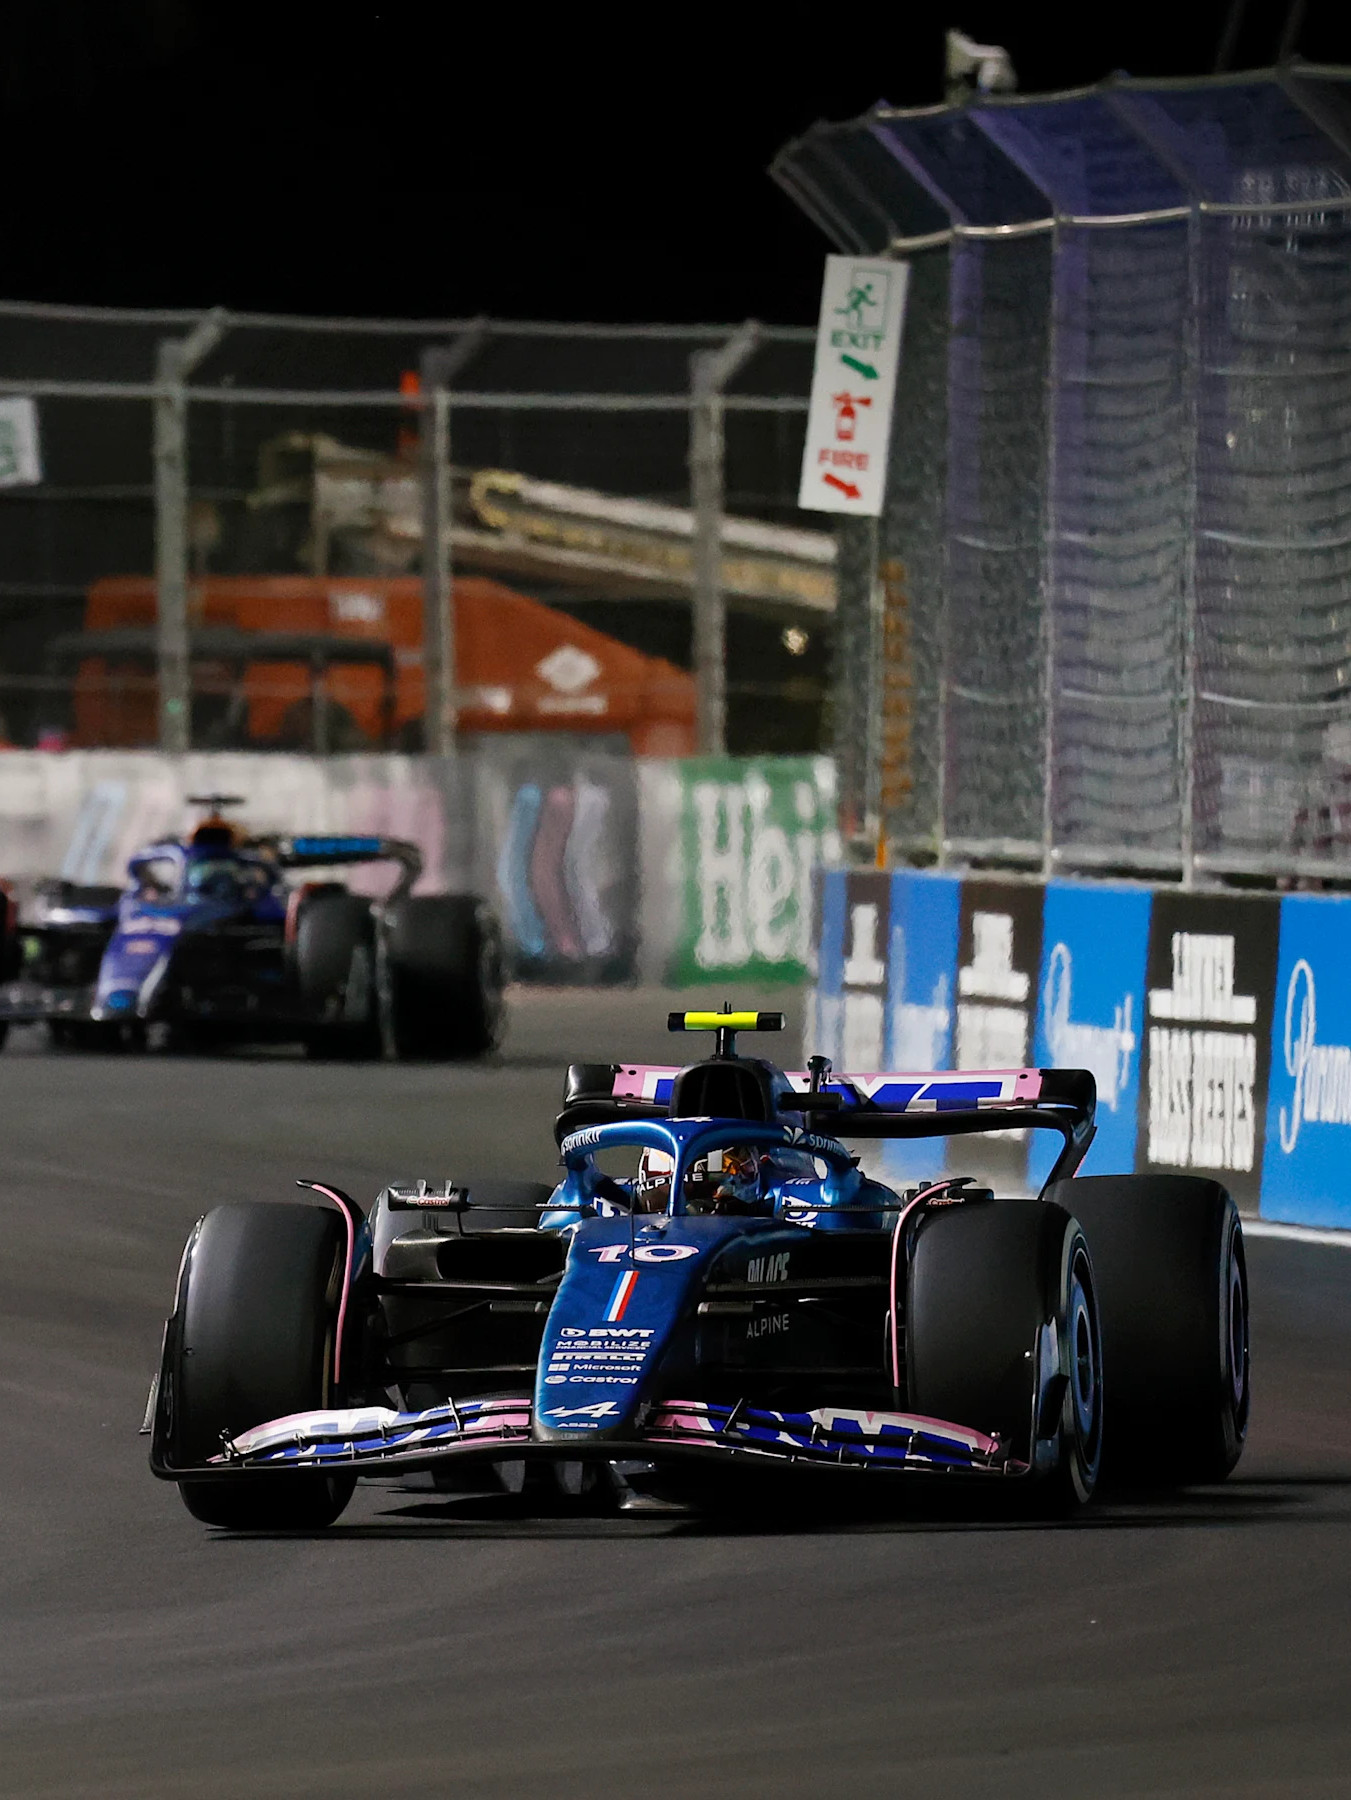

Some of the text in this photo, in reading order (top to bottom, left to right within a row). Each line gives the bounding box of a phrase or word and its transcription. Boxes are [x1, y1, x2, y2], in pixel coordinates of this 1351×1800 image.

[830, 329, 883, 350] EXIT
[817, 448, 869, 471] FIRE
[588, 1244, 700, 1263] 10
[588, 1328, 655, 1338] BWT
[746, 1313, 790, 1339] ALPINE
[557, 1340, 651, 1348] MOBILIZE
[552, 1352, 646, 1361] PIRELLI
[569, 1375, 638, 1384] Castrol
